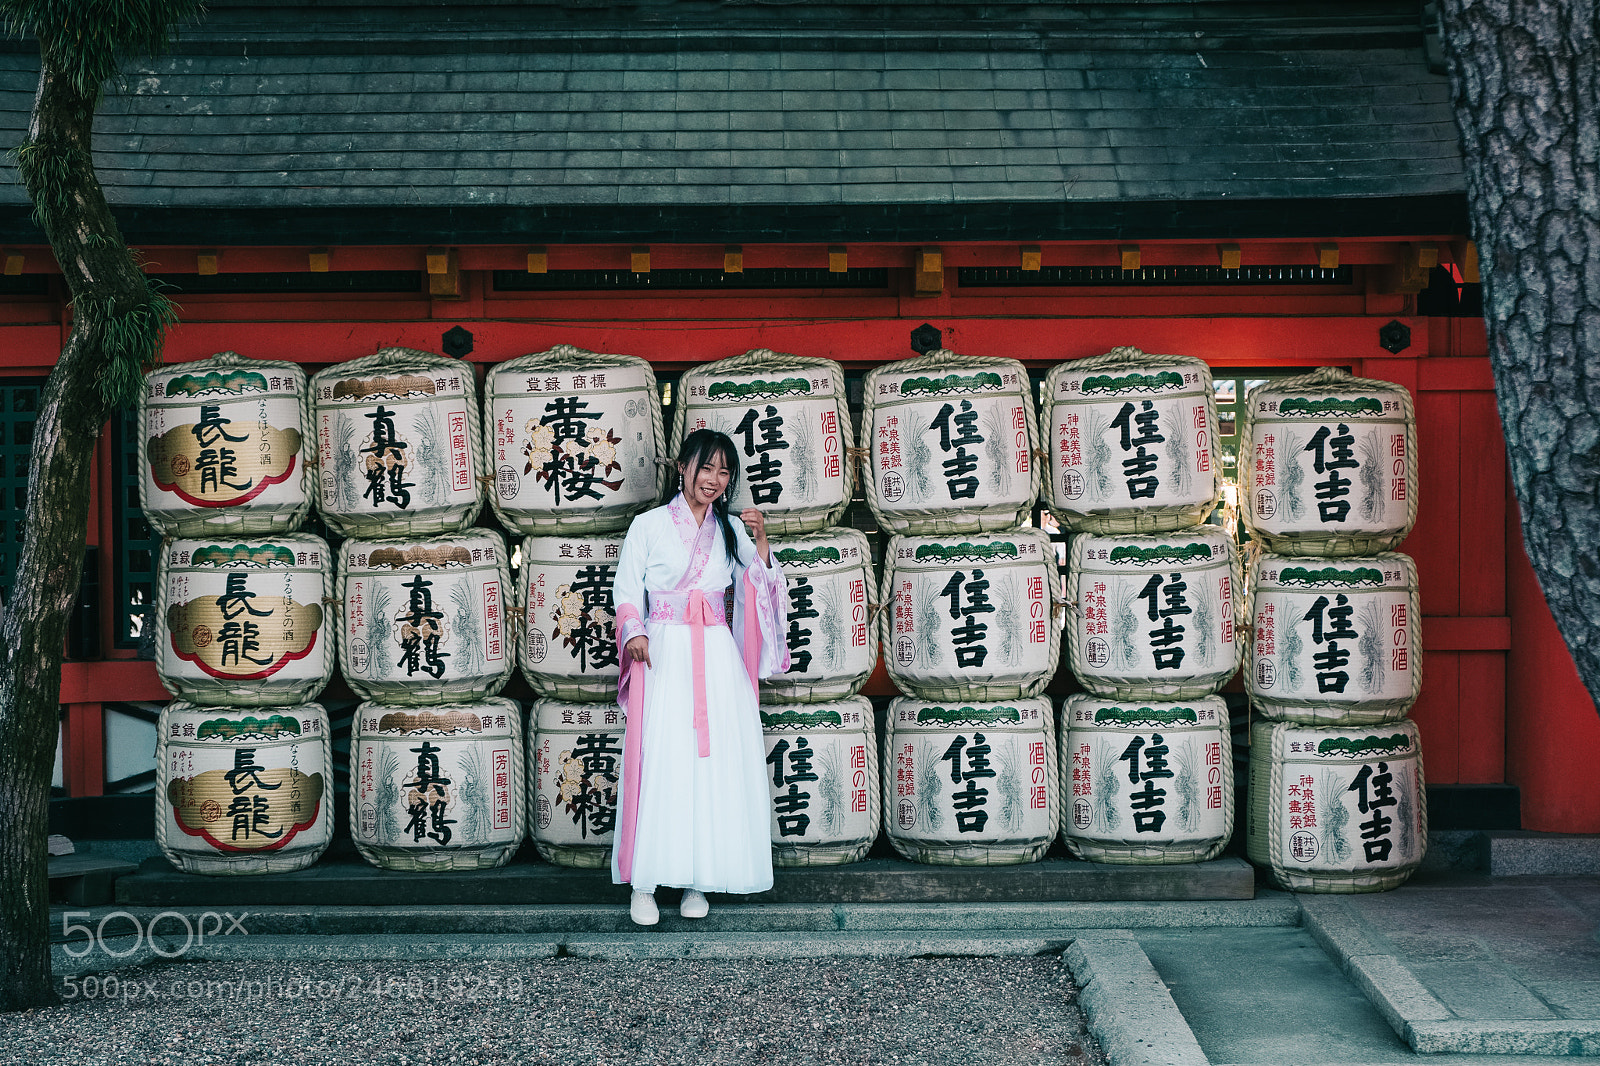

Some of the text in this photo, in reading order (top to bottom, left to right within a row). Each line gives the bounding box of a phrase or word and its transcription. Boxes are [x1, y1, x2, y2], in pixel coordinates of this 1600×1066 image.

[269, 376, 295, 391] 商標
[435, 377, 461, 391] 商標
[572, 373, 607, 389] 商標
[191, 399, 252, 494] 長龍
[360, 405, 416, 509] 真鶴
[451, 416, 468, 485] 芳醇清酒
[539, 396, 606, 507] 黄桜
[733, 404, 790, 505] 住吉
[820, 410, 840, 478] 酒の酒
[929, 398, 985, 500] 住吉
[1011, 406, 1029, 473] 酒の酒
[1109, 399, 1166, 500] 住吉
[1192, 405, 1210, 473] 酒の酒
[1304, 422, 1360, 523] 住吉
[1390, 434, 1406, 501] 酒の酒
[297, 551, 320, 566] 商標
[472, 548, 495, 562] 商標
[215, 572, 274, 667] 長龍
[282, 571, 294, 641] なるほどの酒
[395, 574, 451, 679] 真鶴
[486, 586, 500, 655] 芳醇清酒
[569, 565, 619, 674] 黄桜
[849, 579, 867, 647] 酒の酒
[939, 568, 996, 669] 住吉
[1027, 576, 1045, 643] 酒の酒
[1137, 572, 1193, 670] 住吉
[1219, 576, 1233, 644] 酒の酒
[1391, 604, 1408, 671] 酒の酒
[1303, 593, 1359, 694] 住吉
[170, 723, 195, 737] 登録
[481, 715, 507, 729] 商標
[1290, 741, 1315, 753] 登録
[223, 748, 284, 841] 長龍
[289, 743, 301, 813] なるほどの酒
[403, 741, 458, 846] 真鶴
[496, 754, 509, 823] 芳醇清酒
[765, 736, 819, 837] 住吉
[851, 745, 867, 813] 酒の酒
[941, 732, 996, 833] 住吉
[1028, 742, 1046, 809] 酒の酒
[1119, 733, 1175, 833] 住吉
[1205, 742, 1222, 810] 酒の酒
[1347, 762, 1398, 863] 住吉
